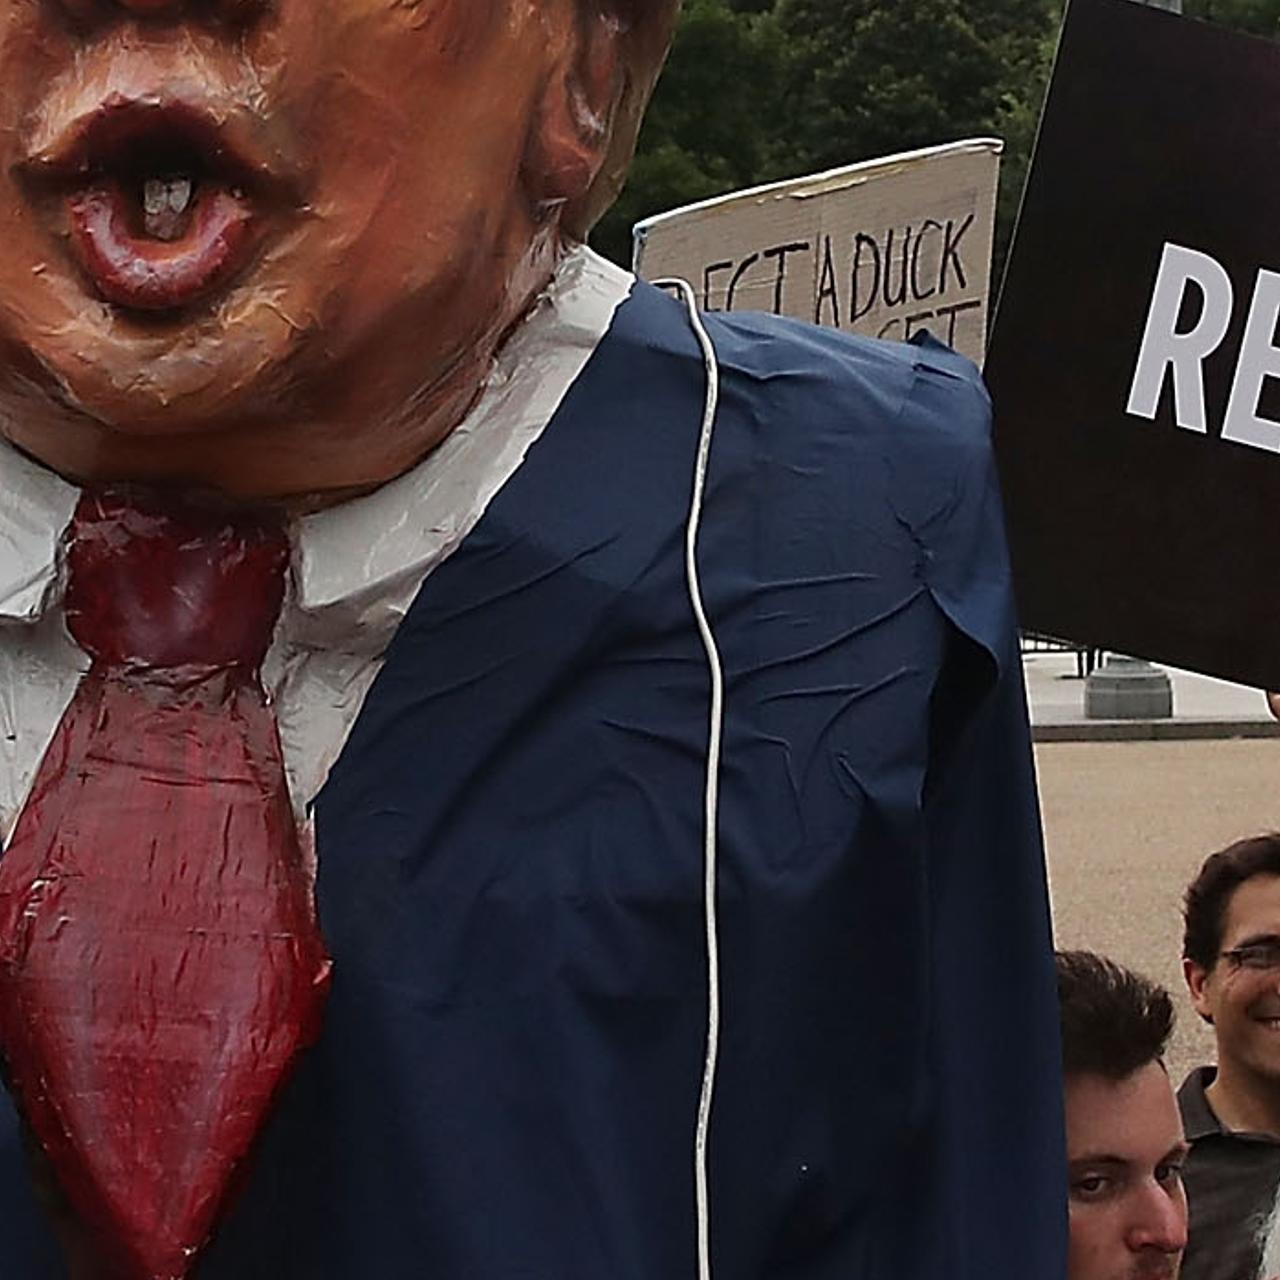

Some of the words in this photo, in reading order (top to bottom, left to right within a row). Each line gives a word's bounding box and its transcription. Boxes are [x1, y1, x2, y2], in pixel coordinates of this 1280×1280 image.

[652, 243, 809, 315] ECT
[816, 235, 840, 327] A
[851, 215, 975, 322] DUCK
